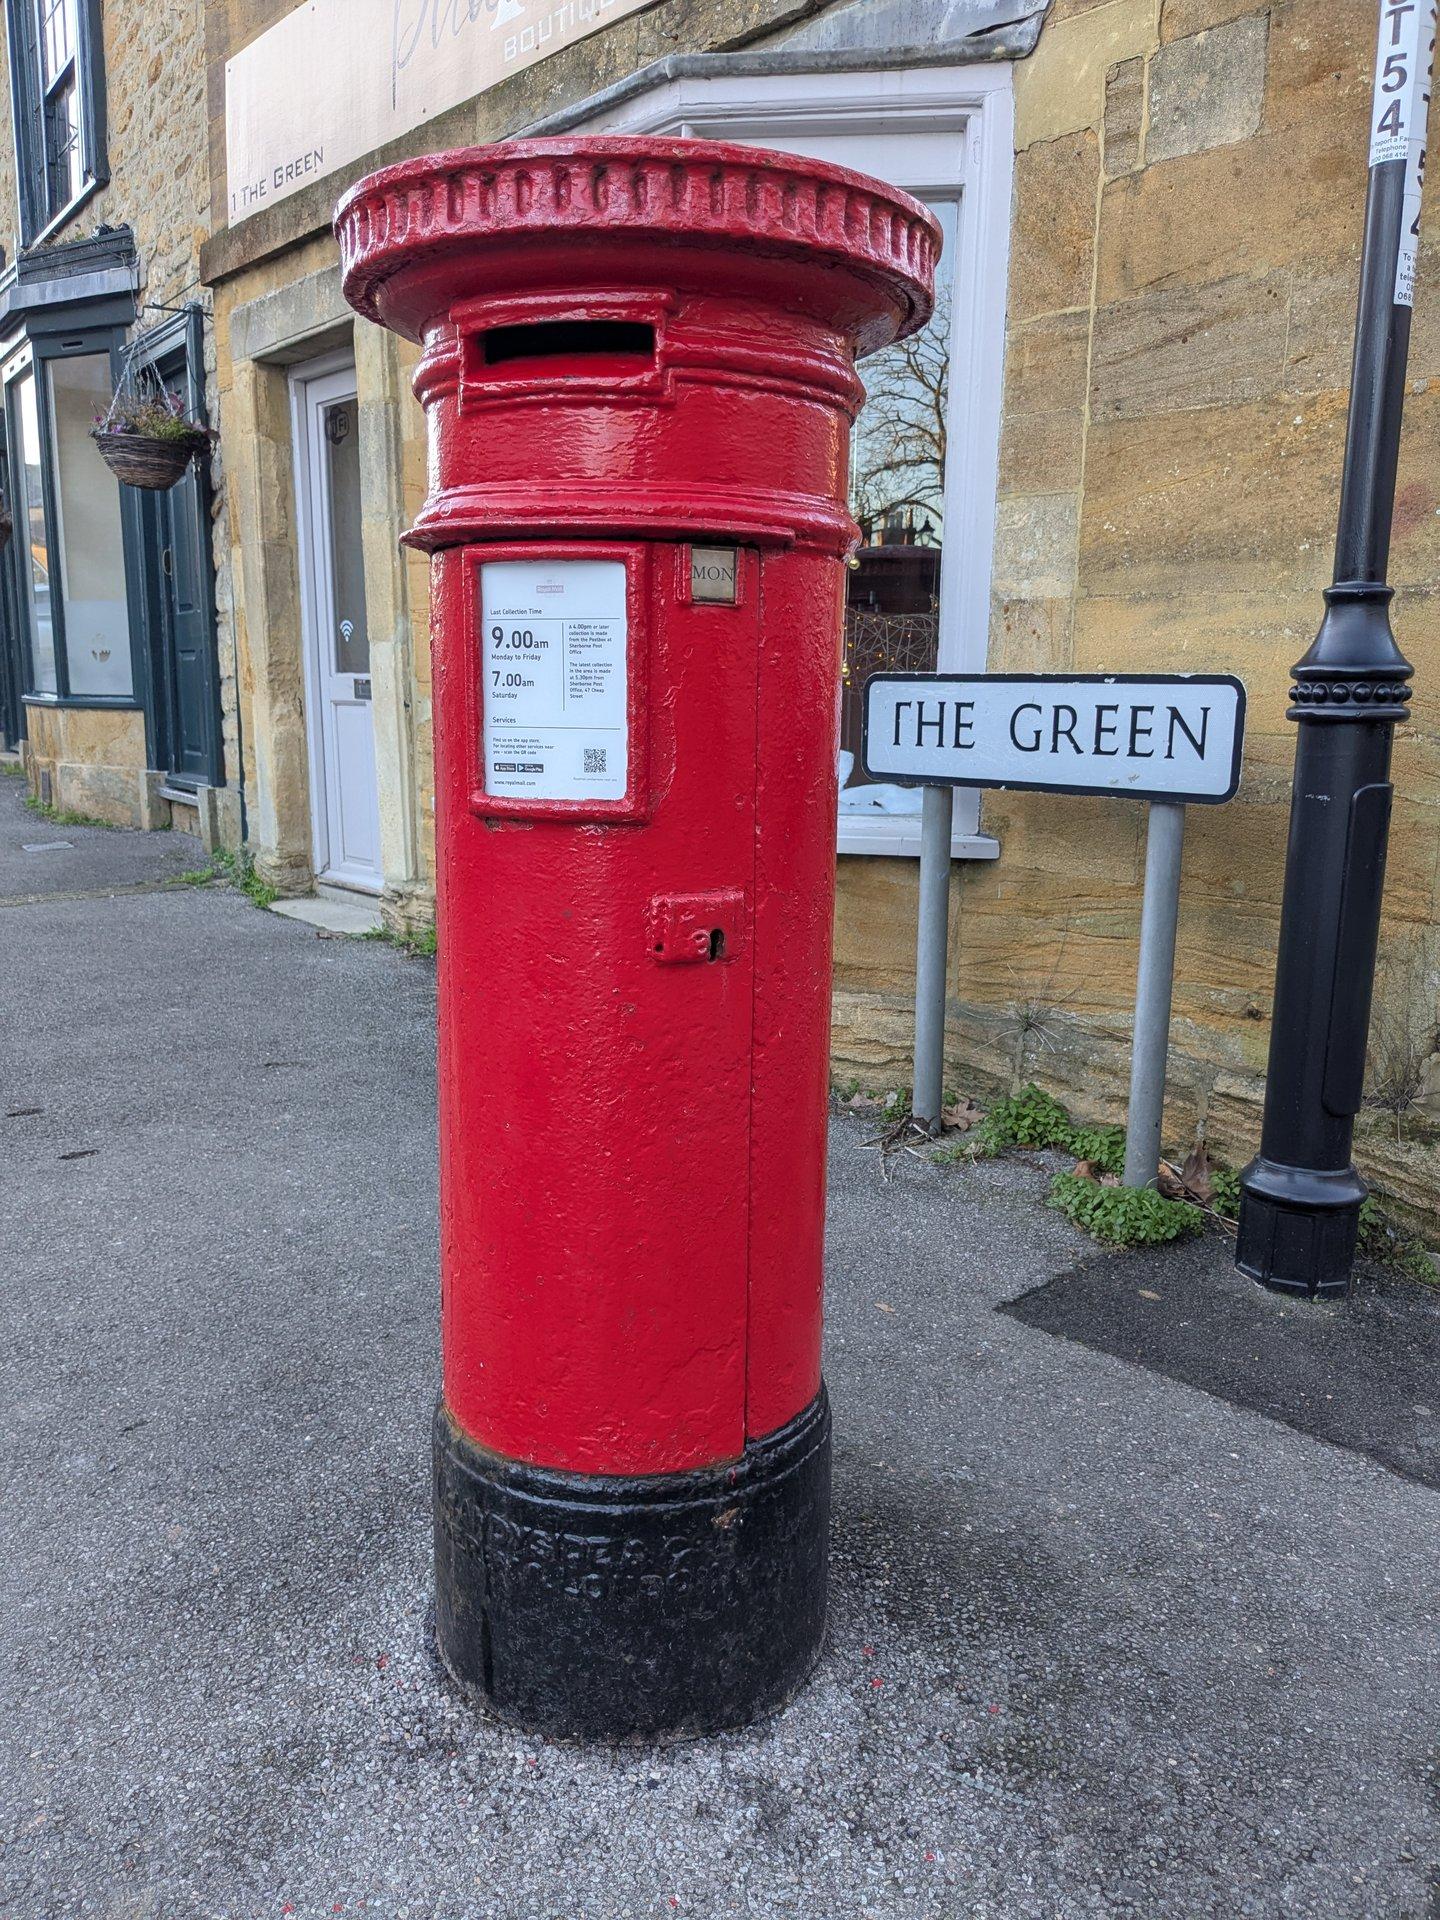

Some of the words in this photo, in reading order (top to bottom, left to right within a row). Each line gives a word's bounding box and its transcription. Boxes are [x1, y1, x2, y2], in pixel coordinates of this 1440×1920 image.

[1376, 144, 1407, 154] Telephone
[232, 193, 236, 211] 1
[1403, 252, 1412, 262] To
[692, 566, 734, 581] MON
[491, 626, 549, 649] 9.00am
[491, 653, 513, 661] Monday
[522, 653, 541, 661] Friday
[491, 670, 535, 687] 7.00am
[491, 691, 518, 699] Saturday
[492, 716, 517, 724] Services
[892, 700, 976, 749] THE
[1008, 703, 1212, 761] GREEN
